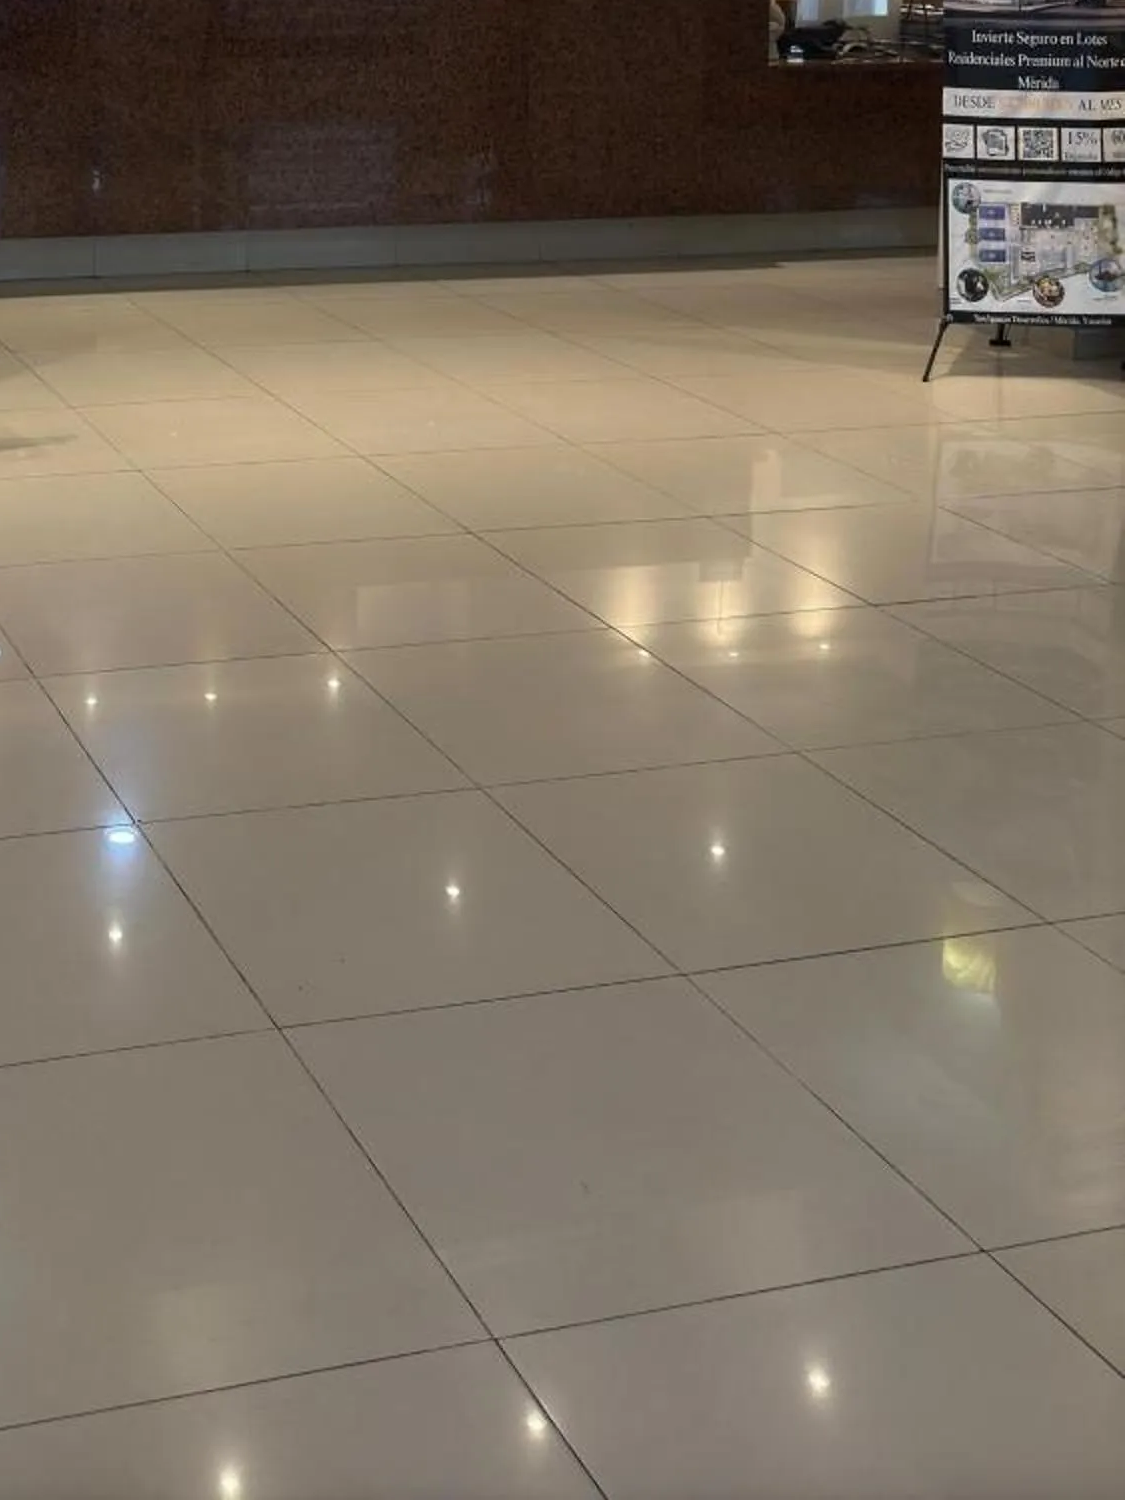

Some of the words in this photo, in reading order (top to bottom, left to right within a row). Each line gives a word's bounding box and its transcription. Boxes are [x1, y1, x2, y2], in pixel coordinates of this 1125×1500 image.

[971, 30, 1014, 45] Invierte
[1016, 31, 1058, 48] Seguro
[1060, 34, 1074, 45] en
[1076, 31, 1108, 46] Lotes
[948, 51, 1016, 67] Residenciales
[1018, 54, 1071, 68] Premium
[1072, 55, 1084, 69] al
[1087, 55, 1119, 69] Norte
[1067, 130, 1098, 146] 15%
